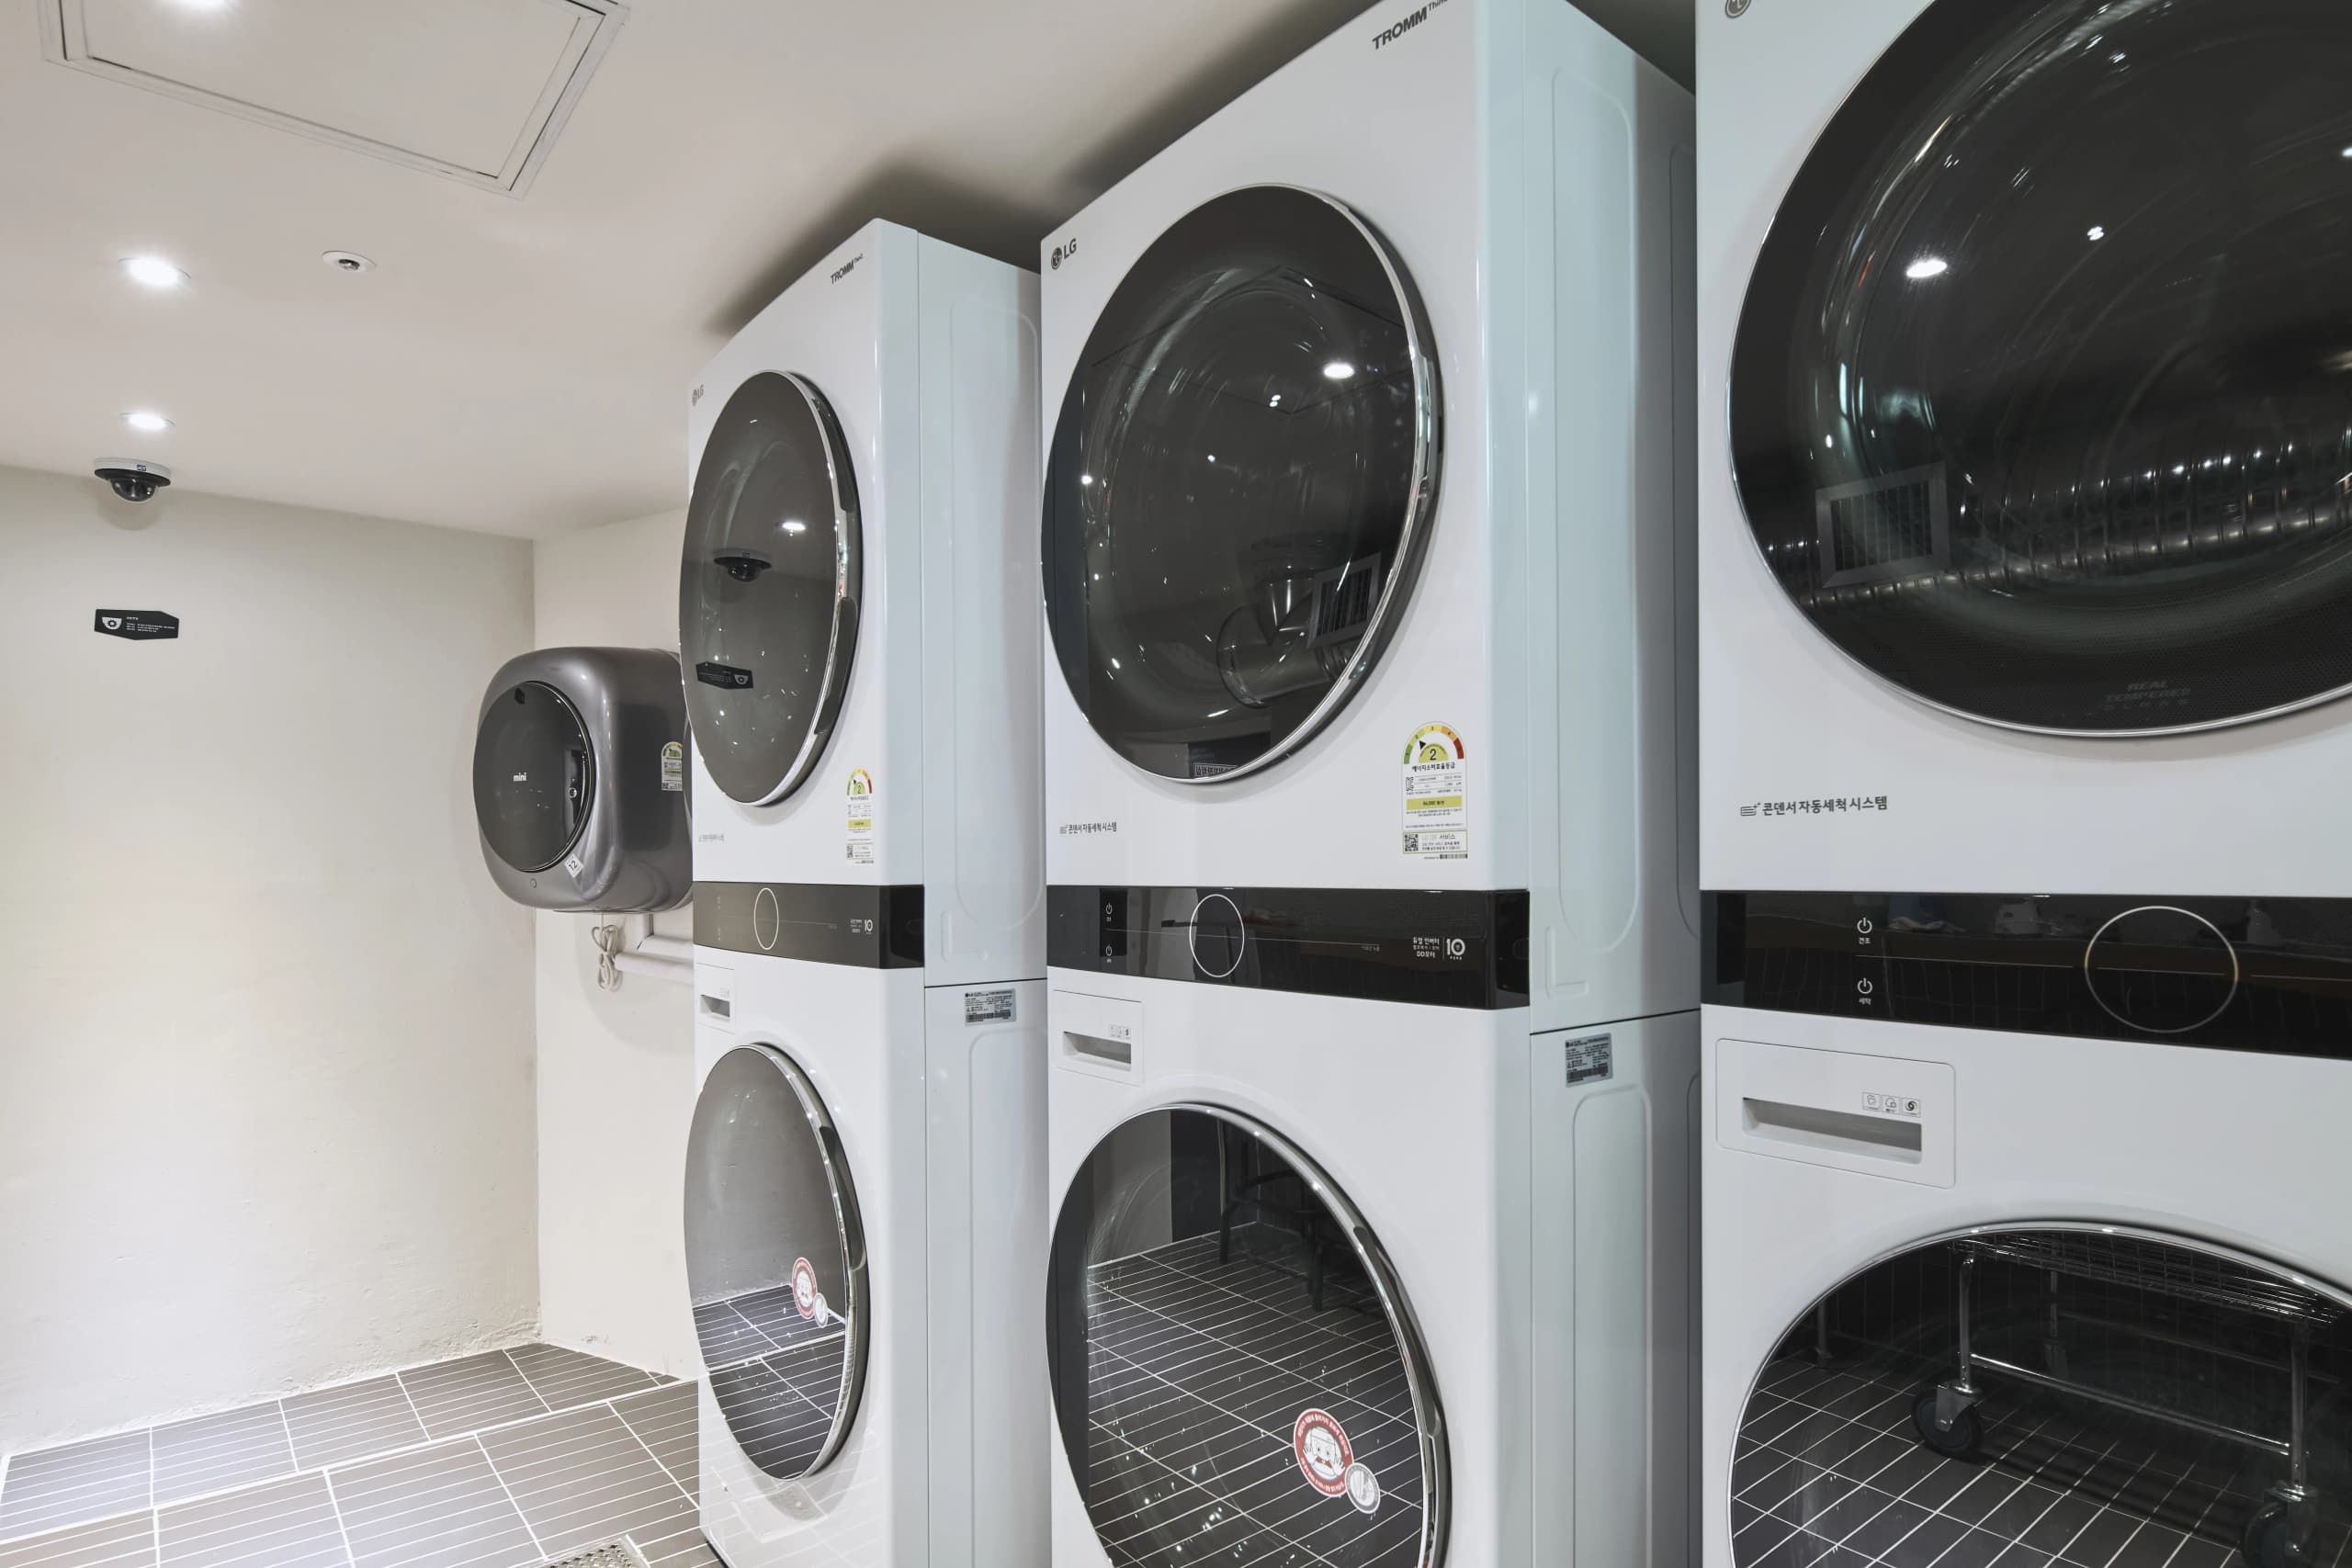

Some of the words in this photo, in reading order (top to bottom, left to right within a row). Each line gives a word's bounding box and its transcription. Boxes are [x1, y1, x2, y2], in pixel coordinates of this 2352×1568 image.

[1372, 6, 1428, 50] TROMM
[1063, 237, 1077, 259] LG
[830, 258, 854, 285] TROMM
[1430, 749, 1437, 761] 2
[513, 772, 527, 782] mini
[1762, 801, 1797, 817] 콘덴서
[1798, 797, 1848, 814] 자동세척
[1849, 795, 1888, 811] 시스템
[568, 860, 578, 871] 12
[1446, 938, 1465, 955] 10
